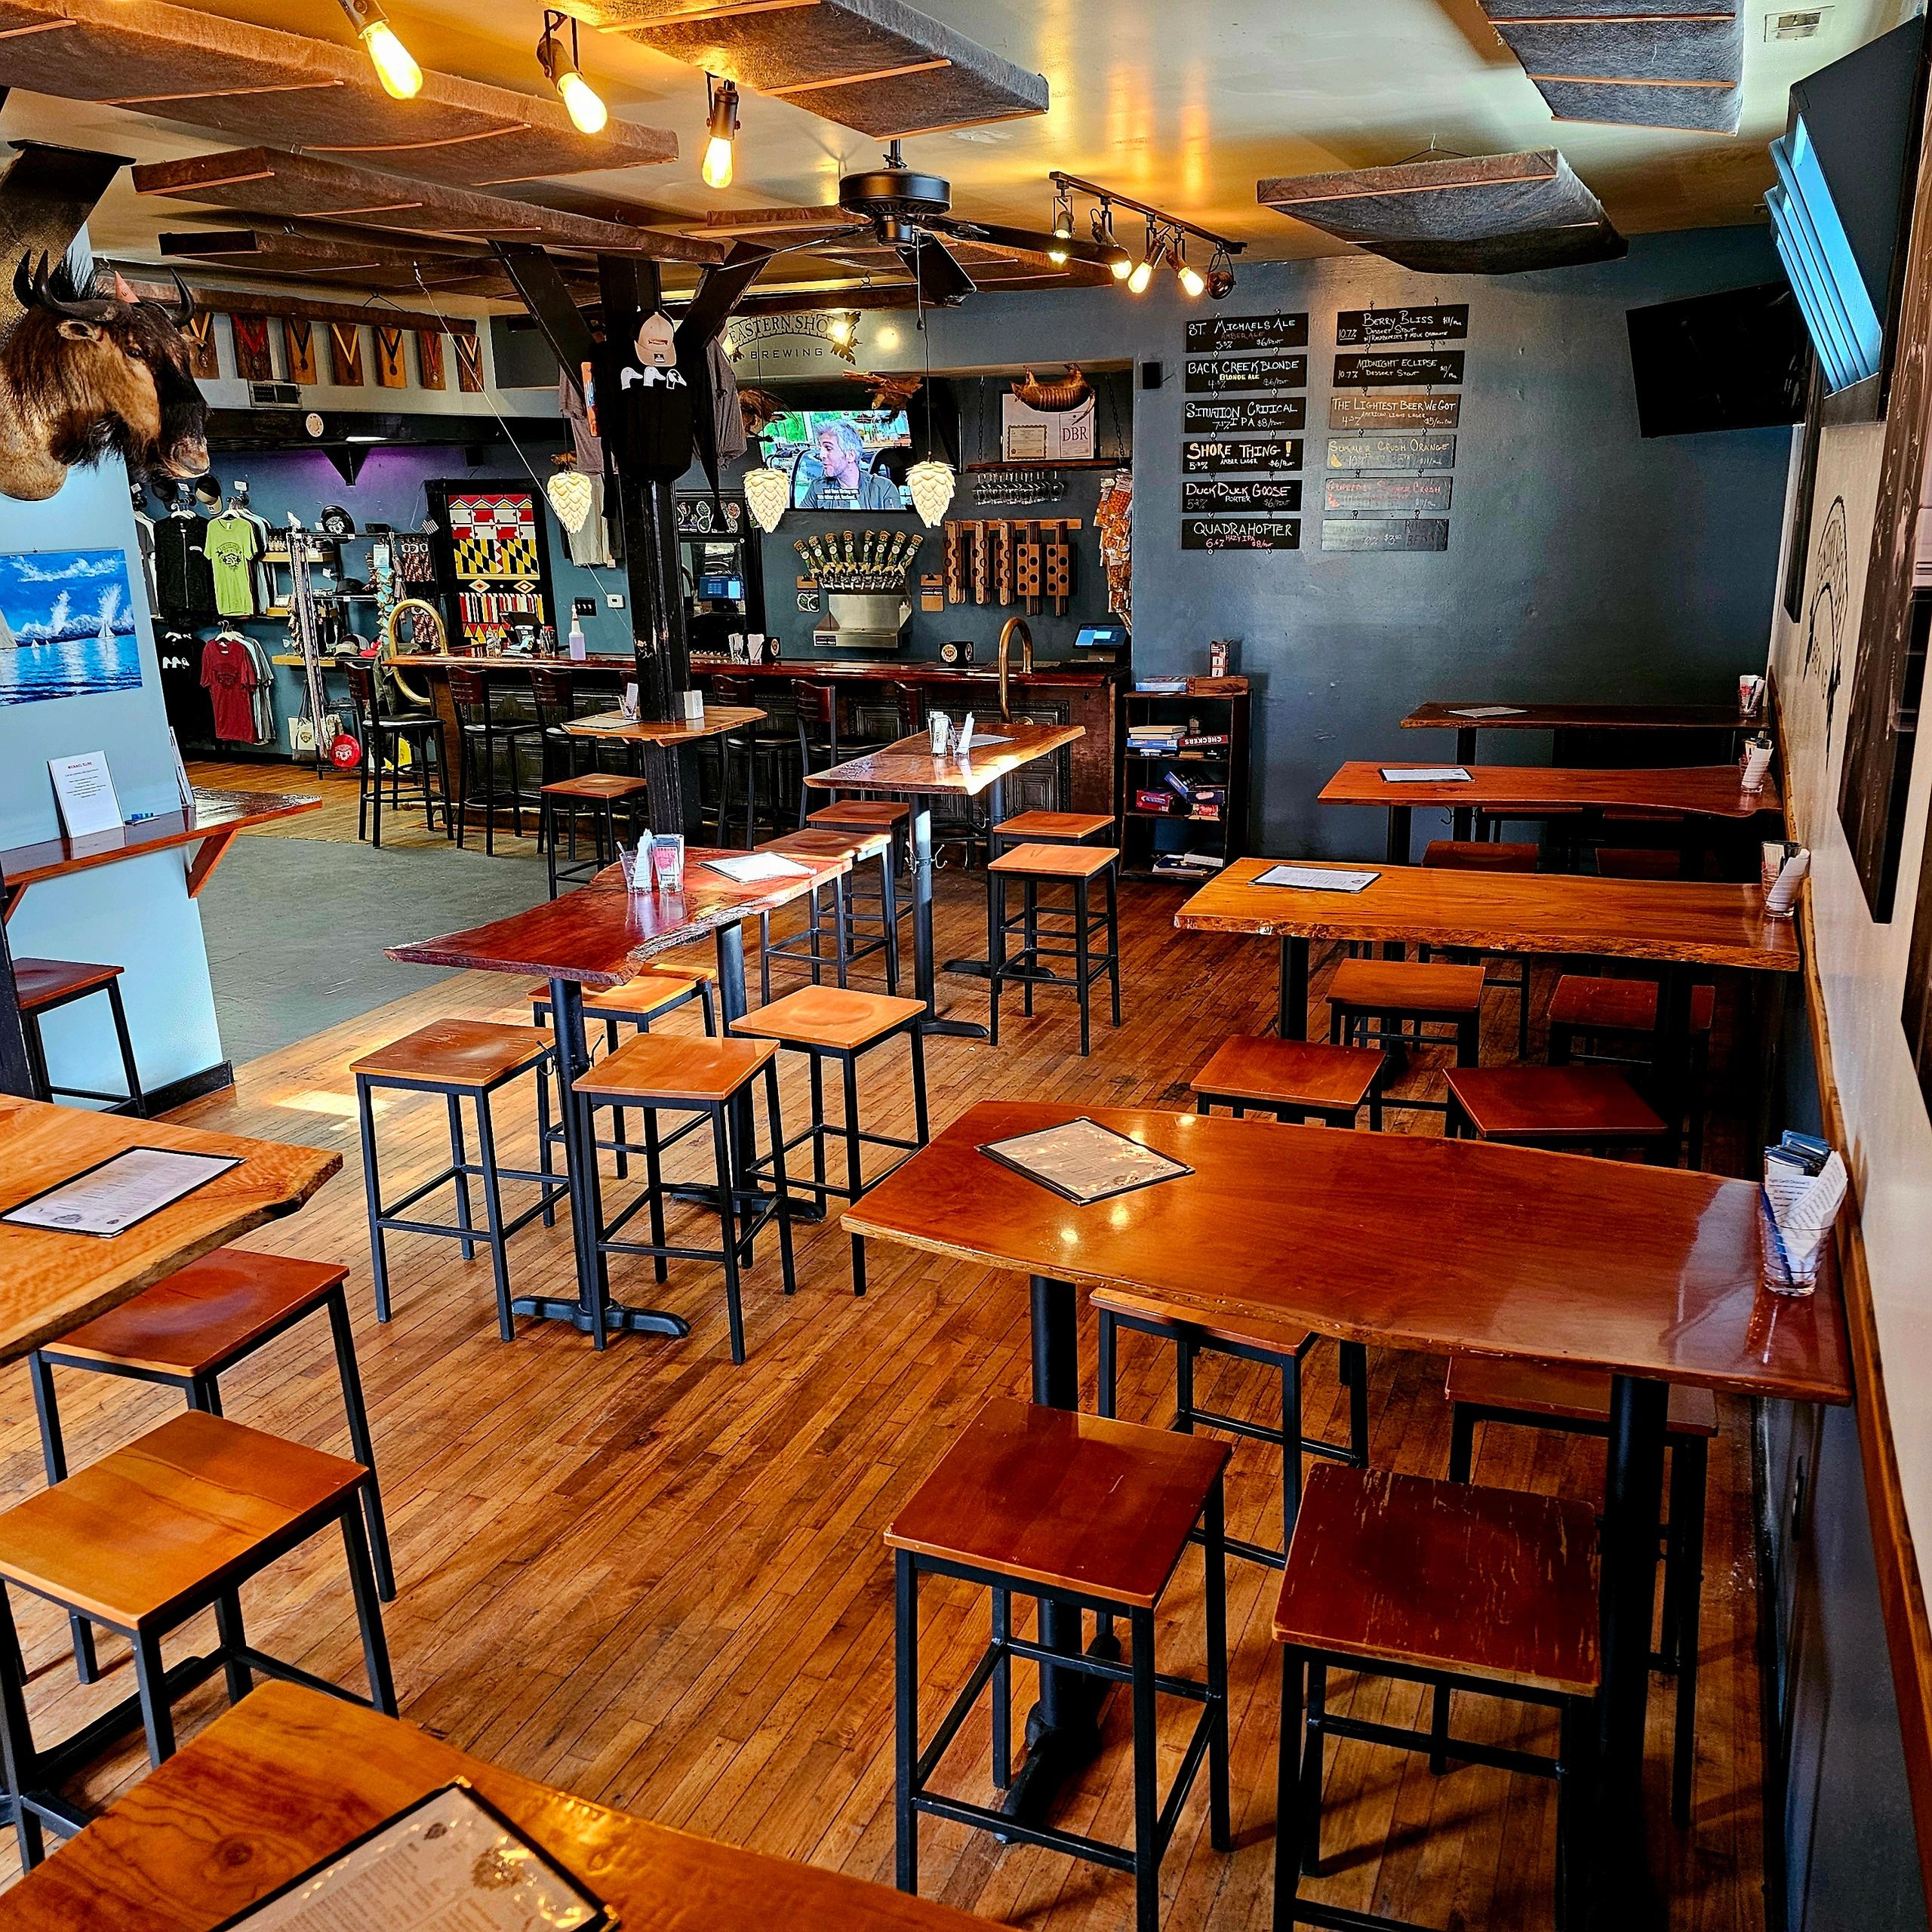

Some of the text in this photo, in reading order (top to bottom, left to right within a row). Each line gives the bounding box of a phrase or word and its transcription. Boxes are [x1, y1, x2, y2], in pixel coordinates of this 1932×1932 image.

[1214, 320, 1270, 334] MICHAELS
[1274, 318, 1296, 332] ALE
[1362, 310, 1433, 330] BERRY BLISS
[729, 315, 792, 344] EASTERN
[1339, 329, 1358, 338] 10.7%
[1395, 325, 1417, 334] STOUT
[750, 349, 823, 359] BREWING
[1188, 361, 1300, 374] BACK CREEK BLONDE
[1357, 359, 1399, 370] MIDNIGHT
[1338, 370, 1358, 379] 10.7%
[1186, 401, 1297, 419] SITUATION CRITICAL
[1332, 398, 1457, 411] THE LIGHTEST BEER WE GOT
[1230, 417, 1255, 426] IPA
[1062, 426, 1088, 441] DBR
[1186, 443, 1232, 460] SHORE
[1239, 445, 1281, 457] THING
[1329, 438, 1449, 453] SUMMER CRUSH ORANGE
[1186, 482, 1291, 498] DUCK DUCK GOOSE
[1413, 481, 1441, 494] CRUSH
[1193, 522, 1293, 537] QUADRAHOPTER
[1184, 736, 1223, 745] CHECKERS
